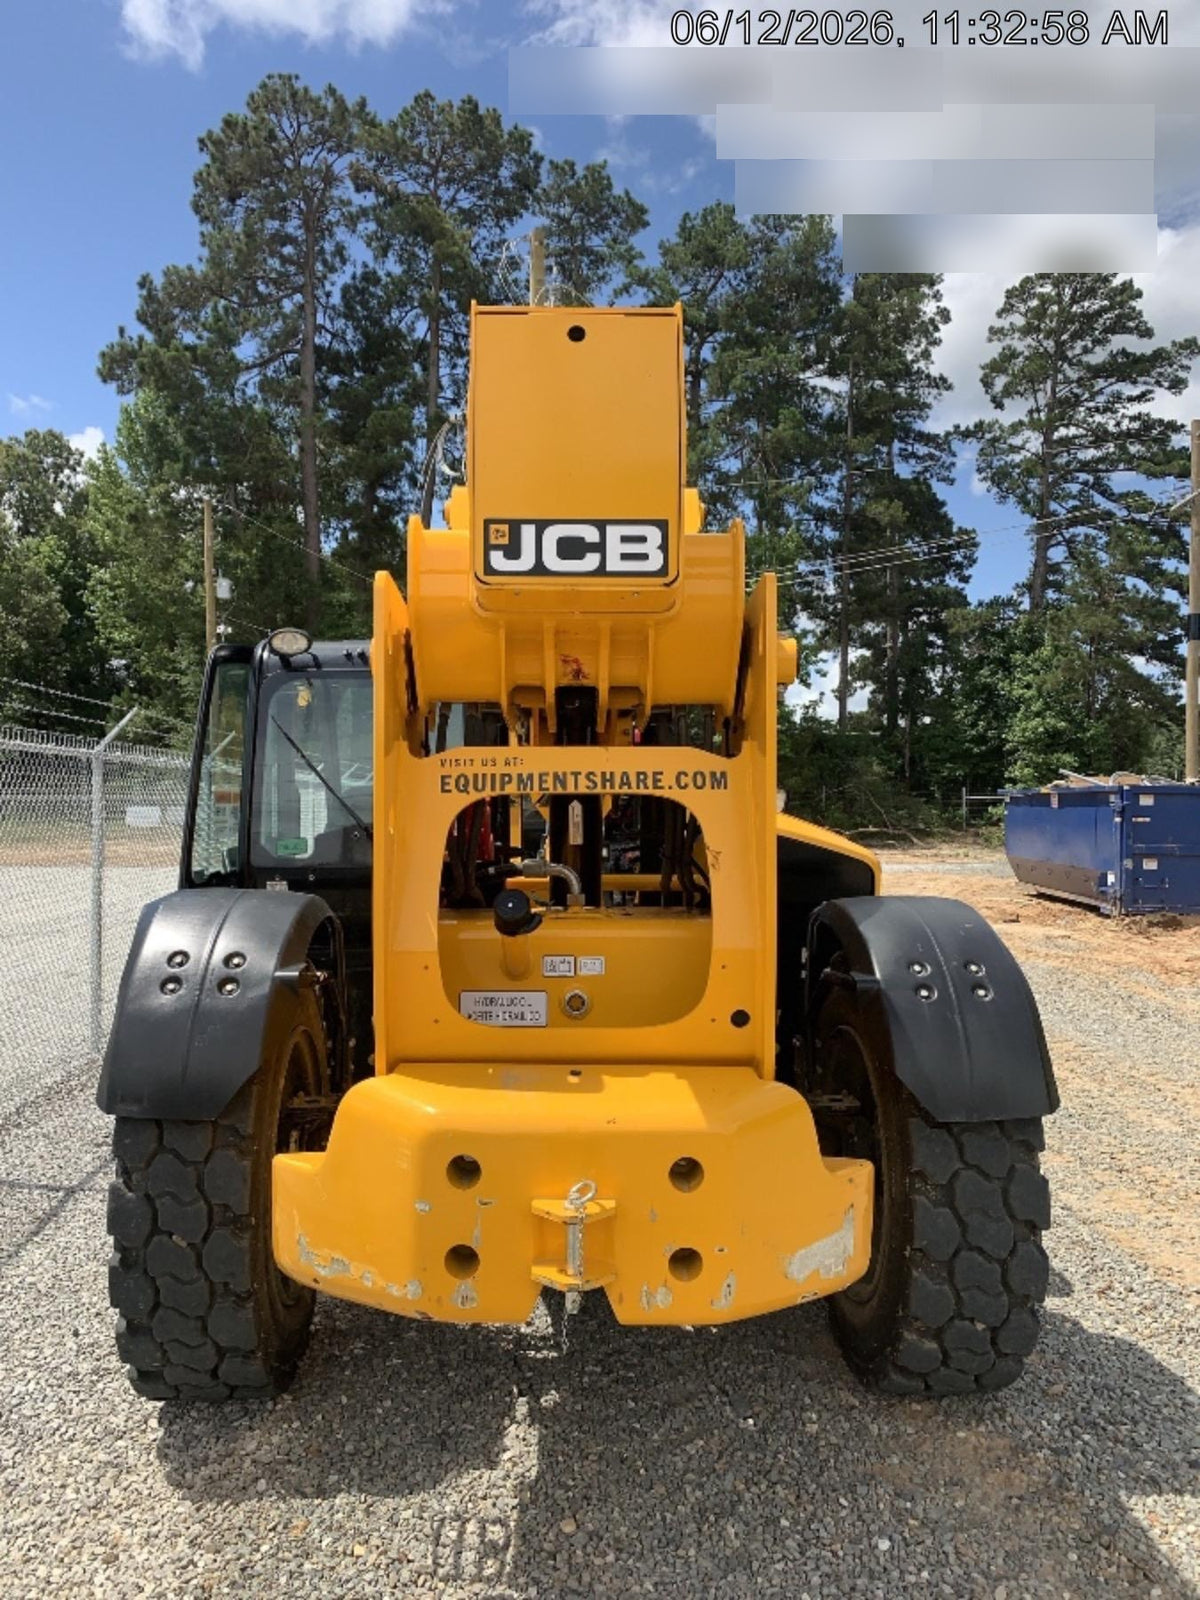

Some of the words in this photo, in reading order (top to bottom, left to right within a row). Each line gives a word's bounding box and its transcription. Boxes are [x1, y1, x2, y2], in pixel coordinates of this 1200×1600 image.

[489, 523, 664, 572] JCB
[440, 757, 475, 768] VISIT
[481, 757, 497, 767] US
[504, 757, 524, 767] AT:
[440, 770, 729, 794] EQUIPMENTSHARE.COM
